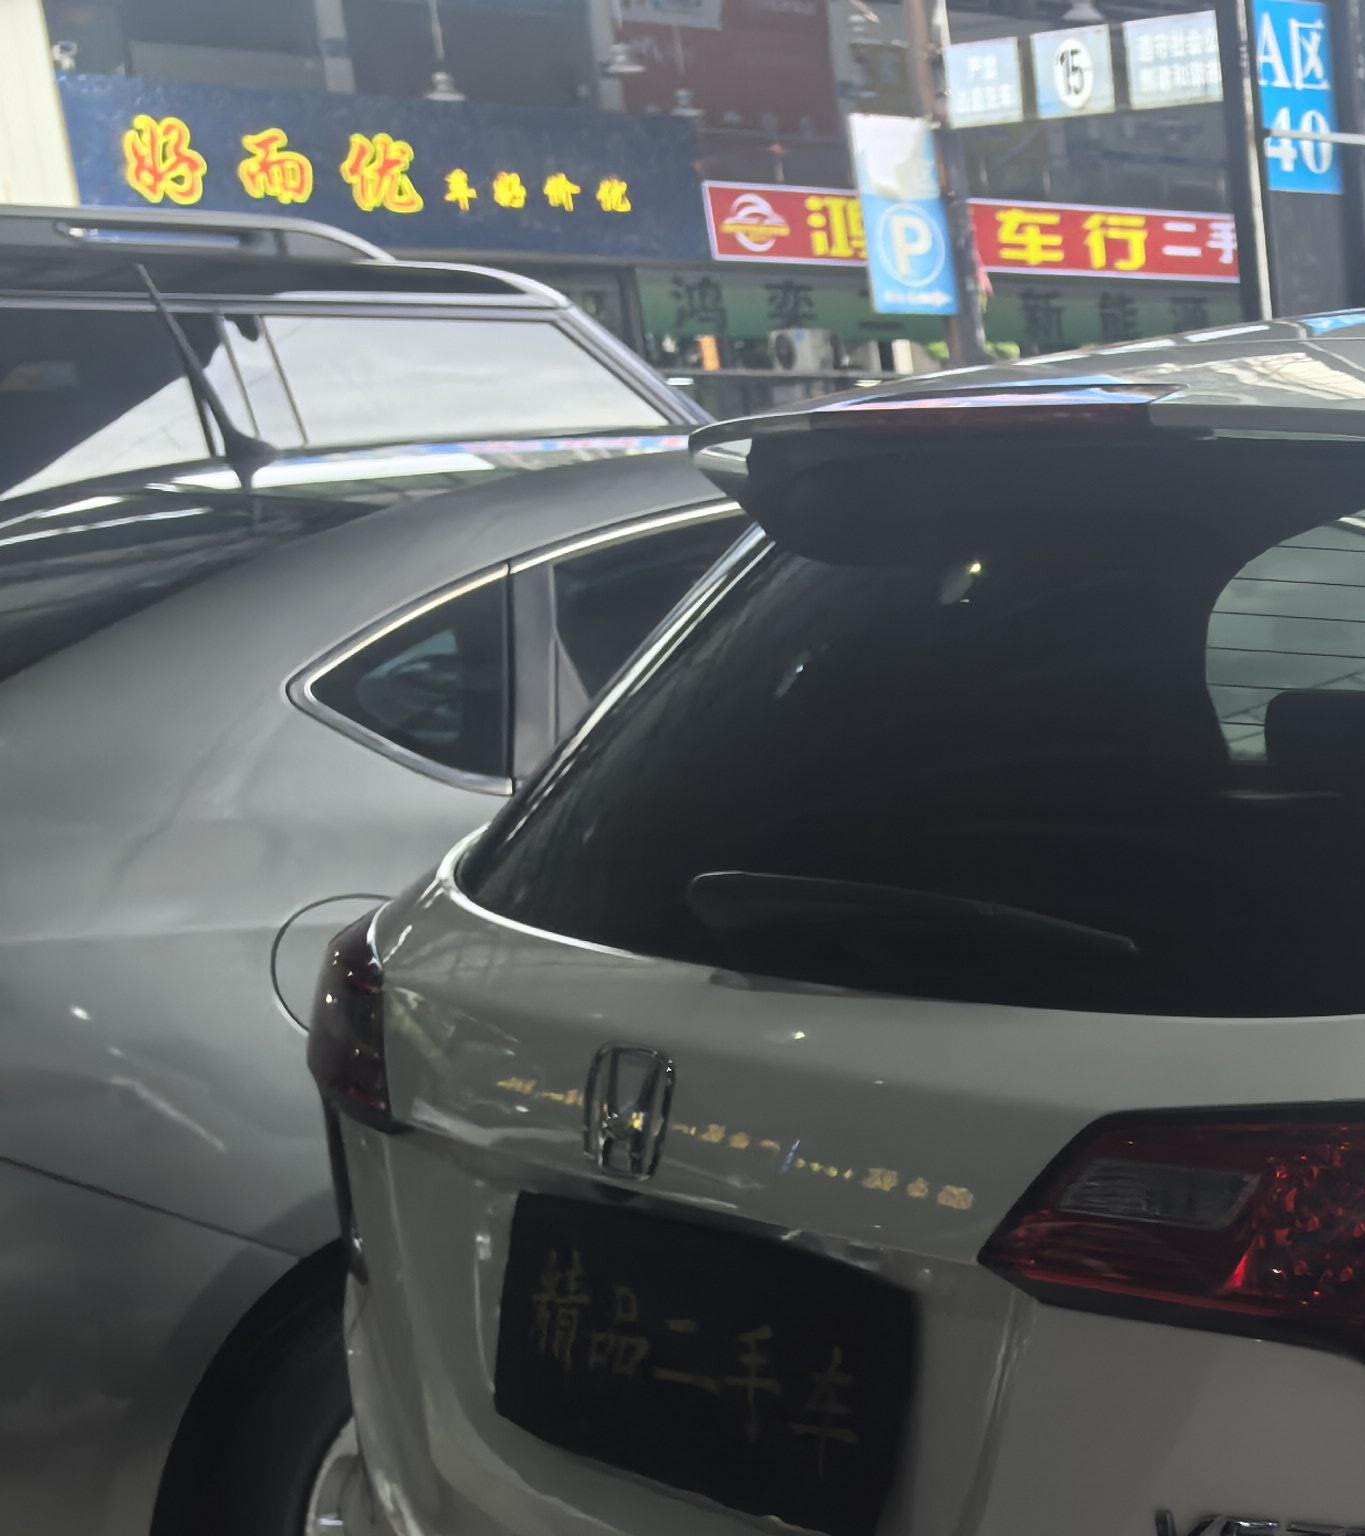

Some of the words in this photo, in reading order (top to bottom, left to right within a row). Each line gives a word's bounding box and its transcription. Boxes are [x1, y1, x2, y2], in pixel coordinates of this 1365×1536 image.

[1059, 48, 1084, 96] 15
[1257, 12, 1330, 90] A区
[1264, 107, 1334, 174] 40
[890, 215, 932, 277] P
[532, 1249, 859, 1478] 精品二手车
